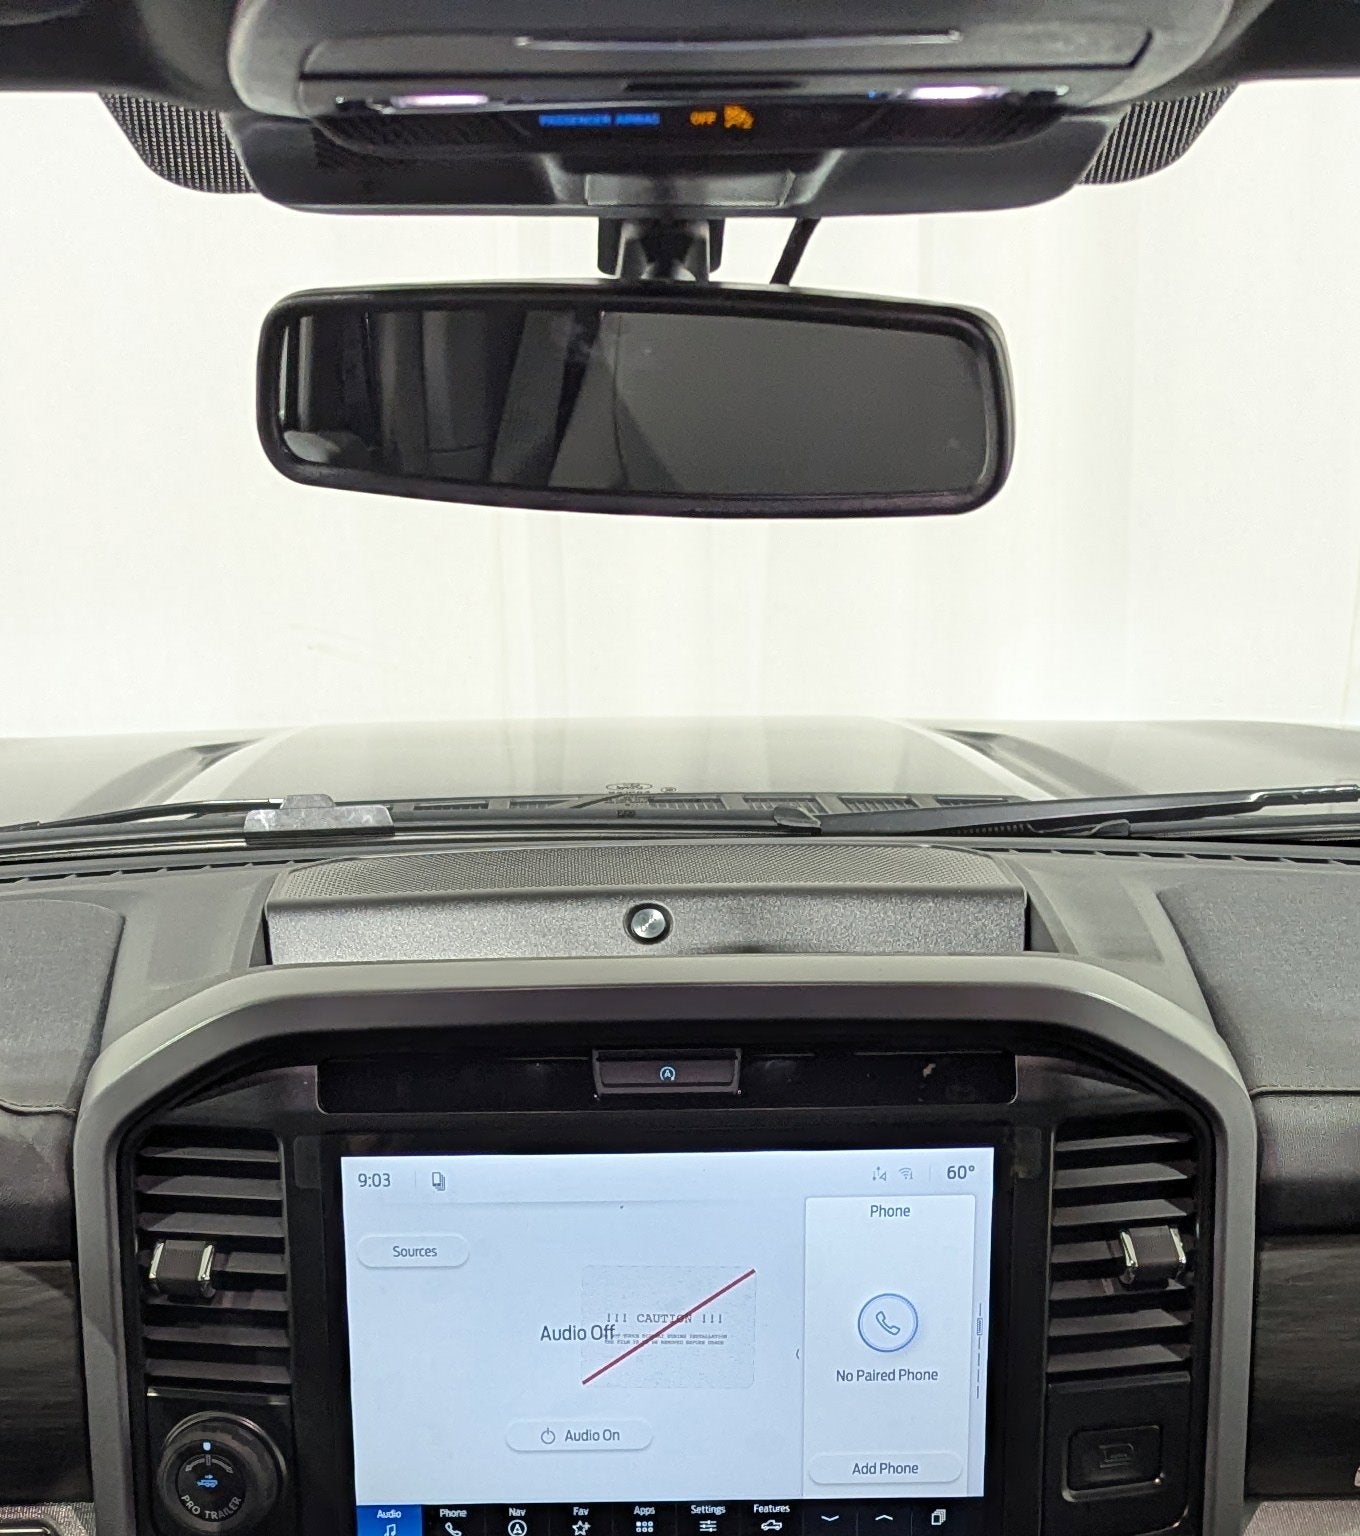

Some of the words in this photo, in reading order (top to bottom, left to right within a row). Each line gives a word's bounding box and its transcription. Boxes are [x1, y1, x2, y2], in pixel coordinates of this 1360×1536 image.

[690, 111, 717, 125] OFF
[357, 1173, 392, 1188] 9:03
[869, 1204, 911, 1218] Phone
[392, 1245, 438, 1258] Sources
[540, 1325, 587, 1342] Audio
[590, 1325, 616, 1341] Off
[835, 1369, 853, 1382] No
[856, 1369, 896, 1382] Paired
[898, 1369, 938, 1382] Phone
[564, 1429, 599, 1442] Audio
[602, 1429, 620, 1441] On
[852, 1462, 877, 1475] Add
[879, 1462, 919, 1475] Phone
[181, 1494, 200, 1514] PRO
[204, 1496, 241, 1519] TRAILER
[439, 1508, 467, 1518] Phone
[509, 1507, 526, 1517] Nav
[573, 1506, 589, 1516] Fav
[634, 1506, 655, 1516] Apps
[690, 1504, 726, 1515] Settings
[753, 1504, 790, 1514] Features
[376, 1509, 402, 1519] Audio
